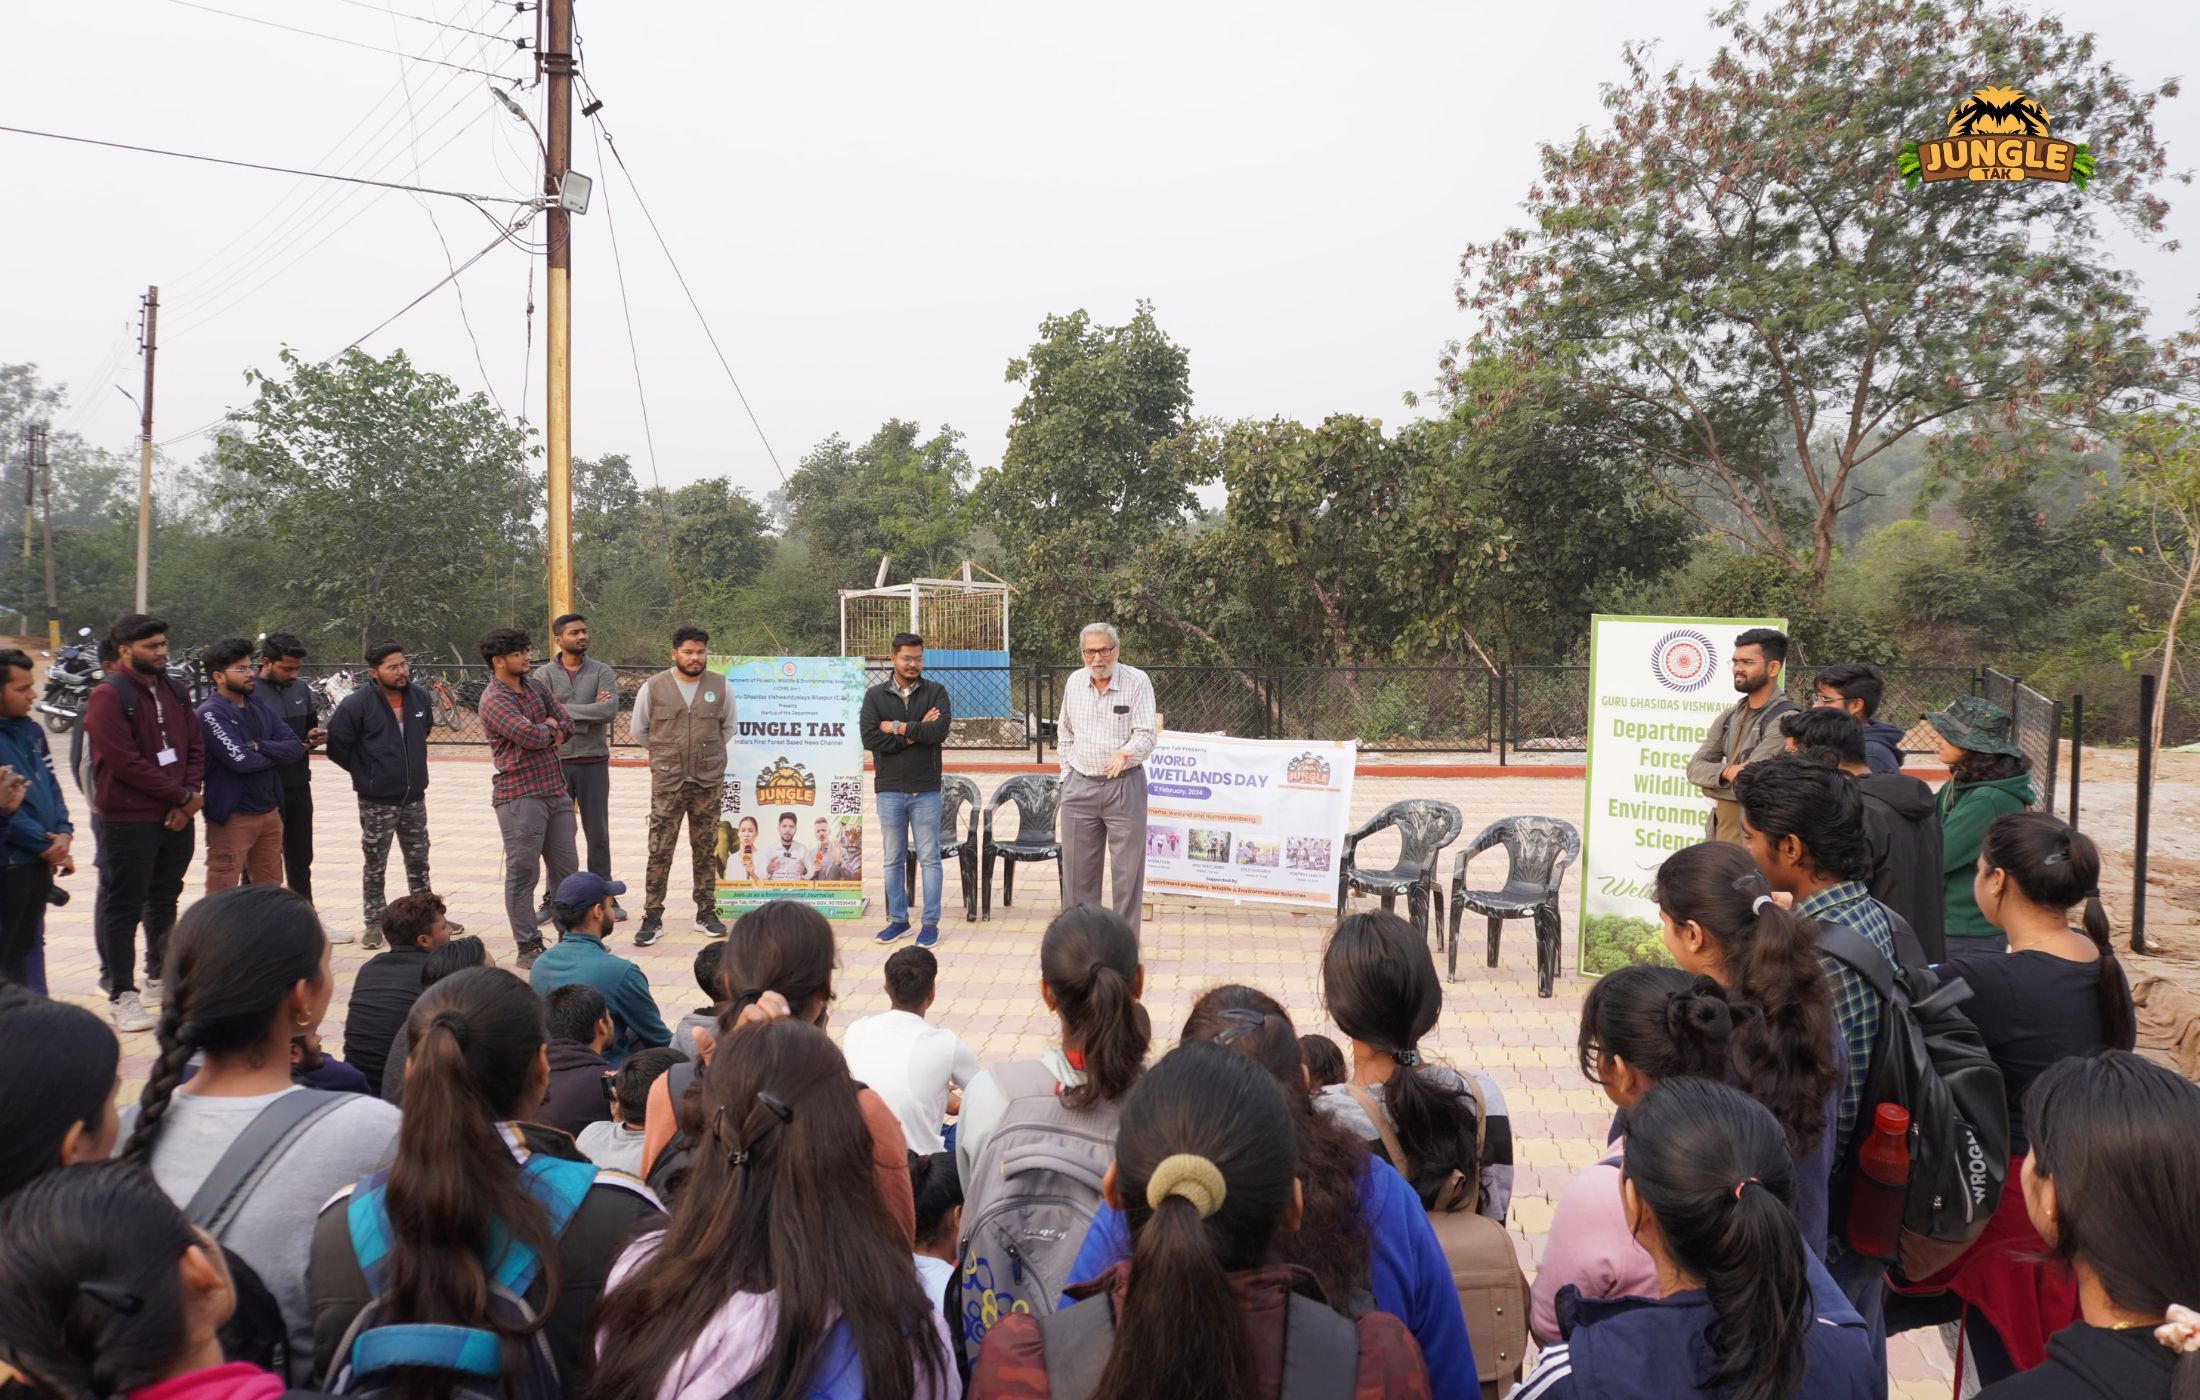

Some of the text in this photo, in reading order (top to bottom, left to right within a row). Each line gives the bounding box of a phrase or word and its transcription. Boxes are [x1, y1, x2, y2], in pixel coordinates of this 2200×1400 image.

[1601, 695, 1737, 713] GURU GHASIDAS VISHWAV
[738, 721, 846, 737] UNGLE TAK
[1613, 719, 1710, 743] Departme
[1150, 754, 1197, 767] WORLD
[1640, 748, 1695, 770] Fores
[1149, 767, 1232, 785] WETLANDS
[1234, 773, 1269, 788] DAY
[1289, 771, 1329, 783] JUNGLE
[759, 788, 813, 802] JUNGLE
[1188, 788, 1203, 796] 2024
[1237, 888, 1280, 896] Environmental
